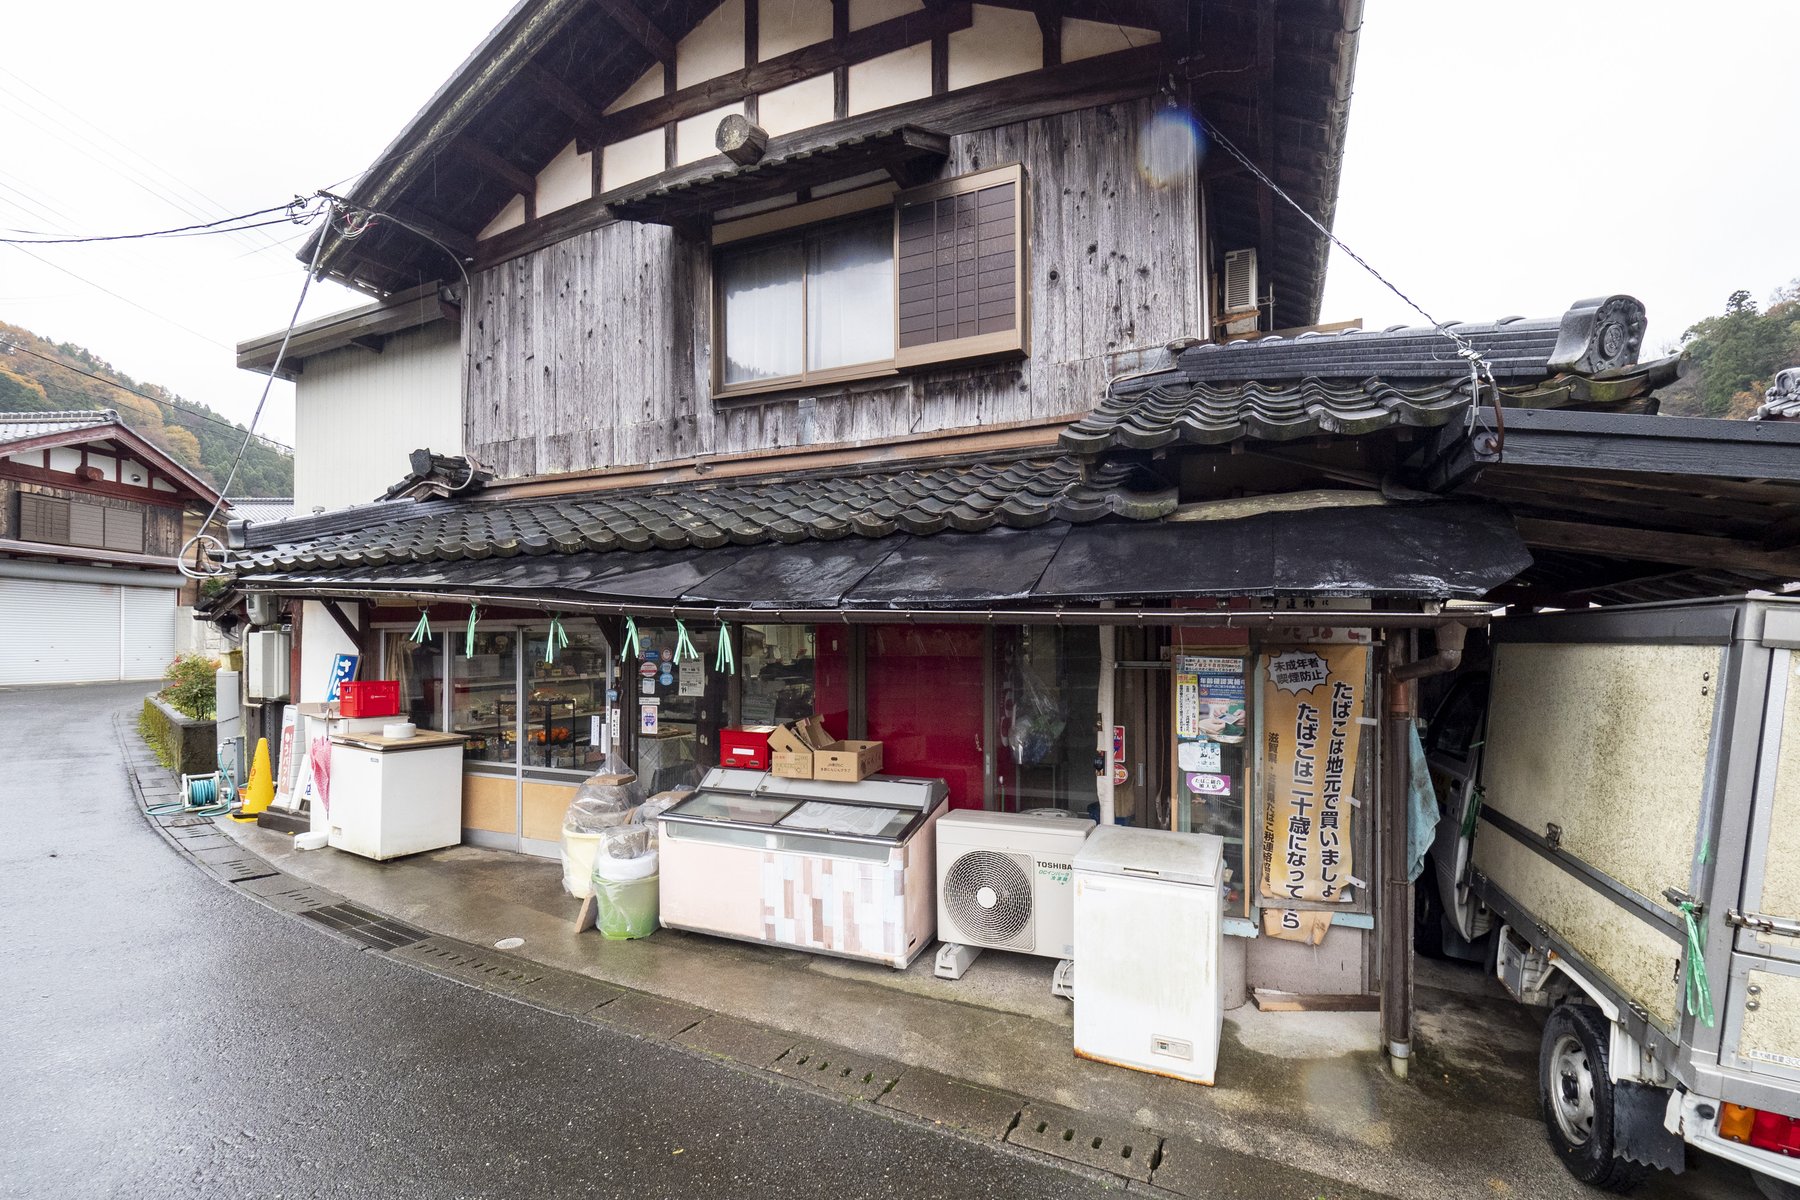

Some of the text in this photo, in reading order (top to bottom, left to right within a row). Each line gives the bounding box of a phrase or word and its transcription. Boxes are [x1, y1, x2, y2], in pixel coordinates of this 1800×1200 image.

[1273, 657, 1320, 673] 未成年者
[1276, 670, 1325, 685] 喫煙防止
[1282, 702, 1319, 930] たばこは二十歳になってら
[1037, 861, 1072, 870] TOSHIBA
